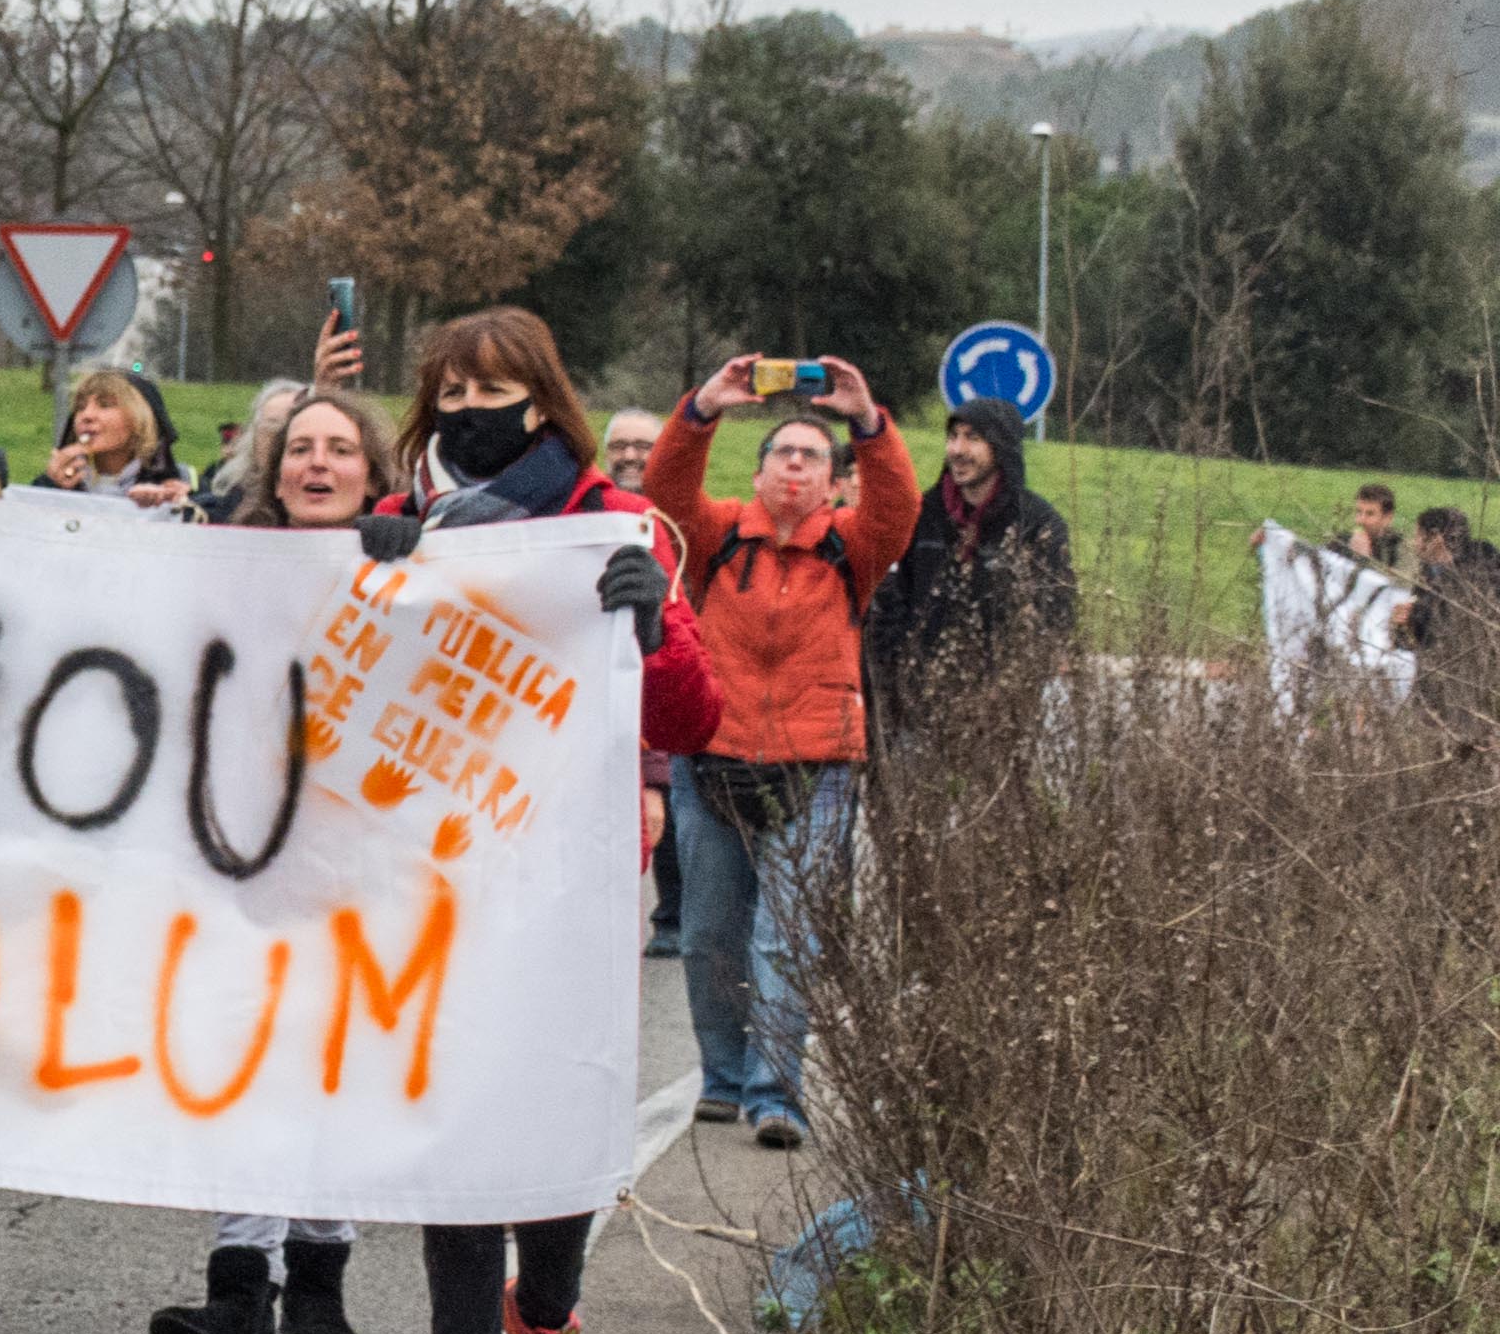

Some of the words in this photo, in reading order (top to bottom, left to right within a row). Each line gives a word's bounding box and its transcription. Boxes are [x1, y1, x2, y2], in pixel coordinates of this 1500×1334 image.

[350, 559, 408, 616] LA
[324, 603, 394, 674] EN
[407, 658, 514, 742] PEU
[371, 700, 534, 833] GUERRA
